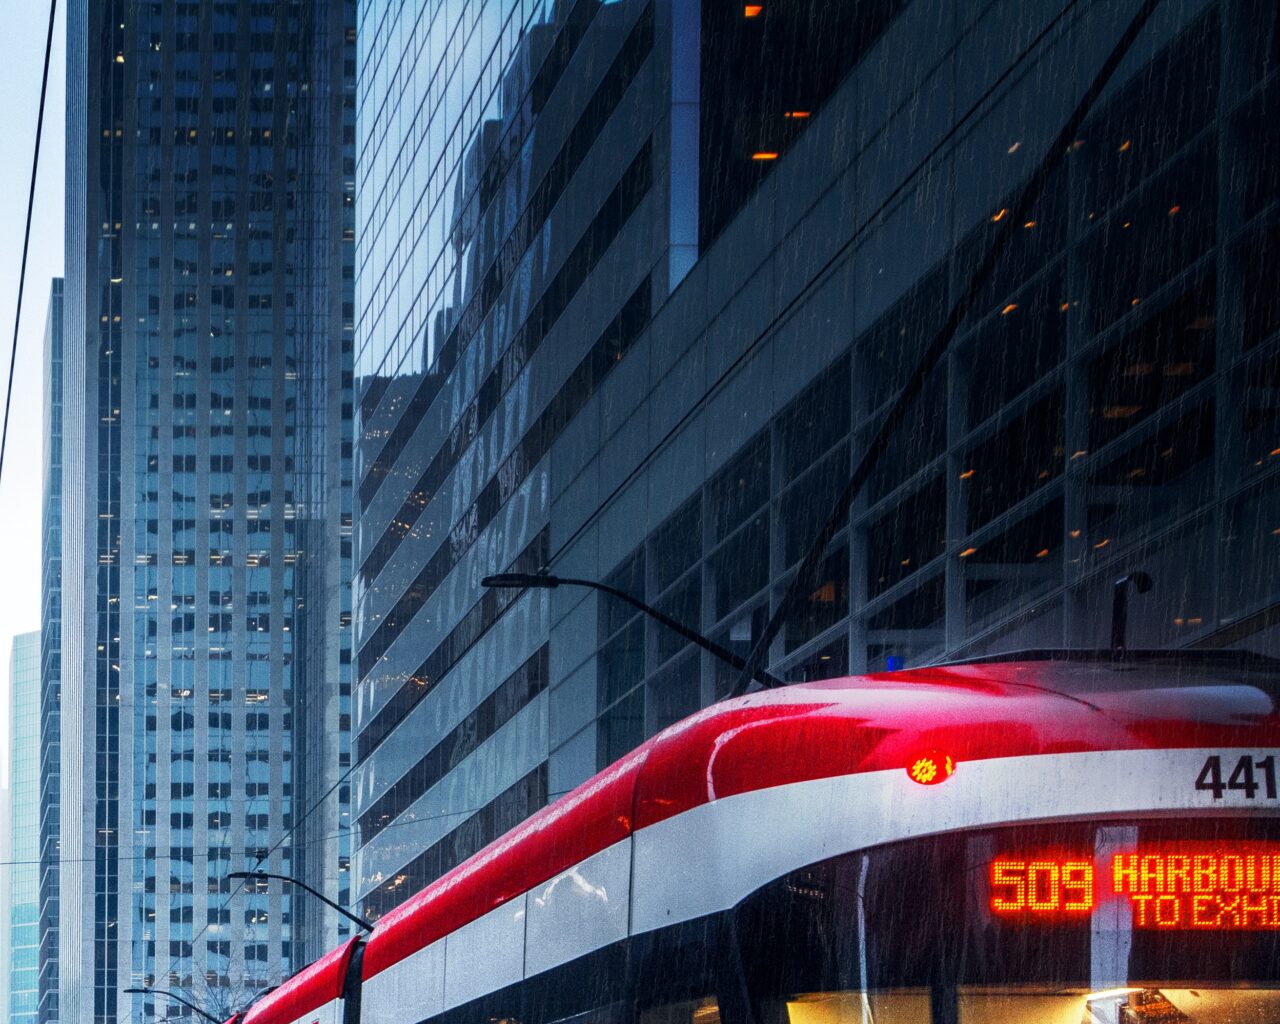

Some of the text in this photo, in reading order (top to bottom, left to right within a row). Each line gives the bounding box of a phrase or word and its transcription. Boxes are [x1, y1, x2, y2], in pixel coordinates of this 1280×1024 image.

[1195, 755, 1277, 799] 441
[993, 861, 1094, 911] 509
[1131, 895, 1180, 926] TO
